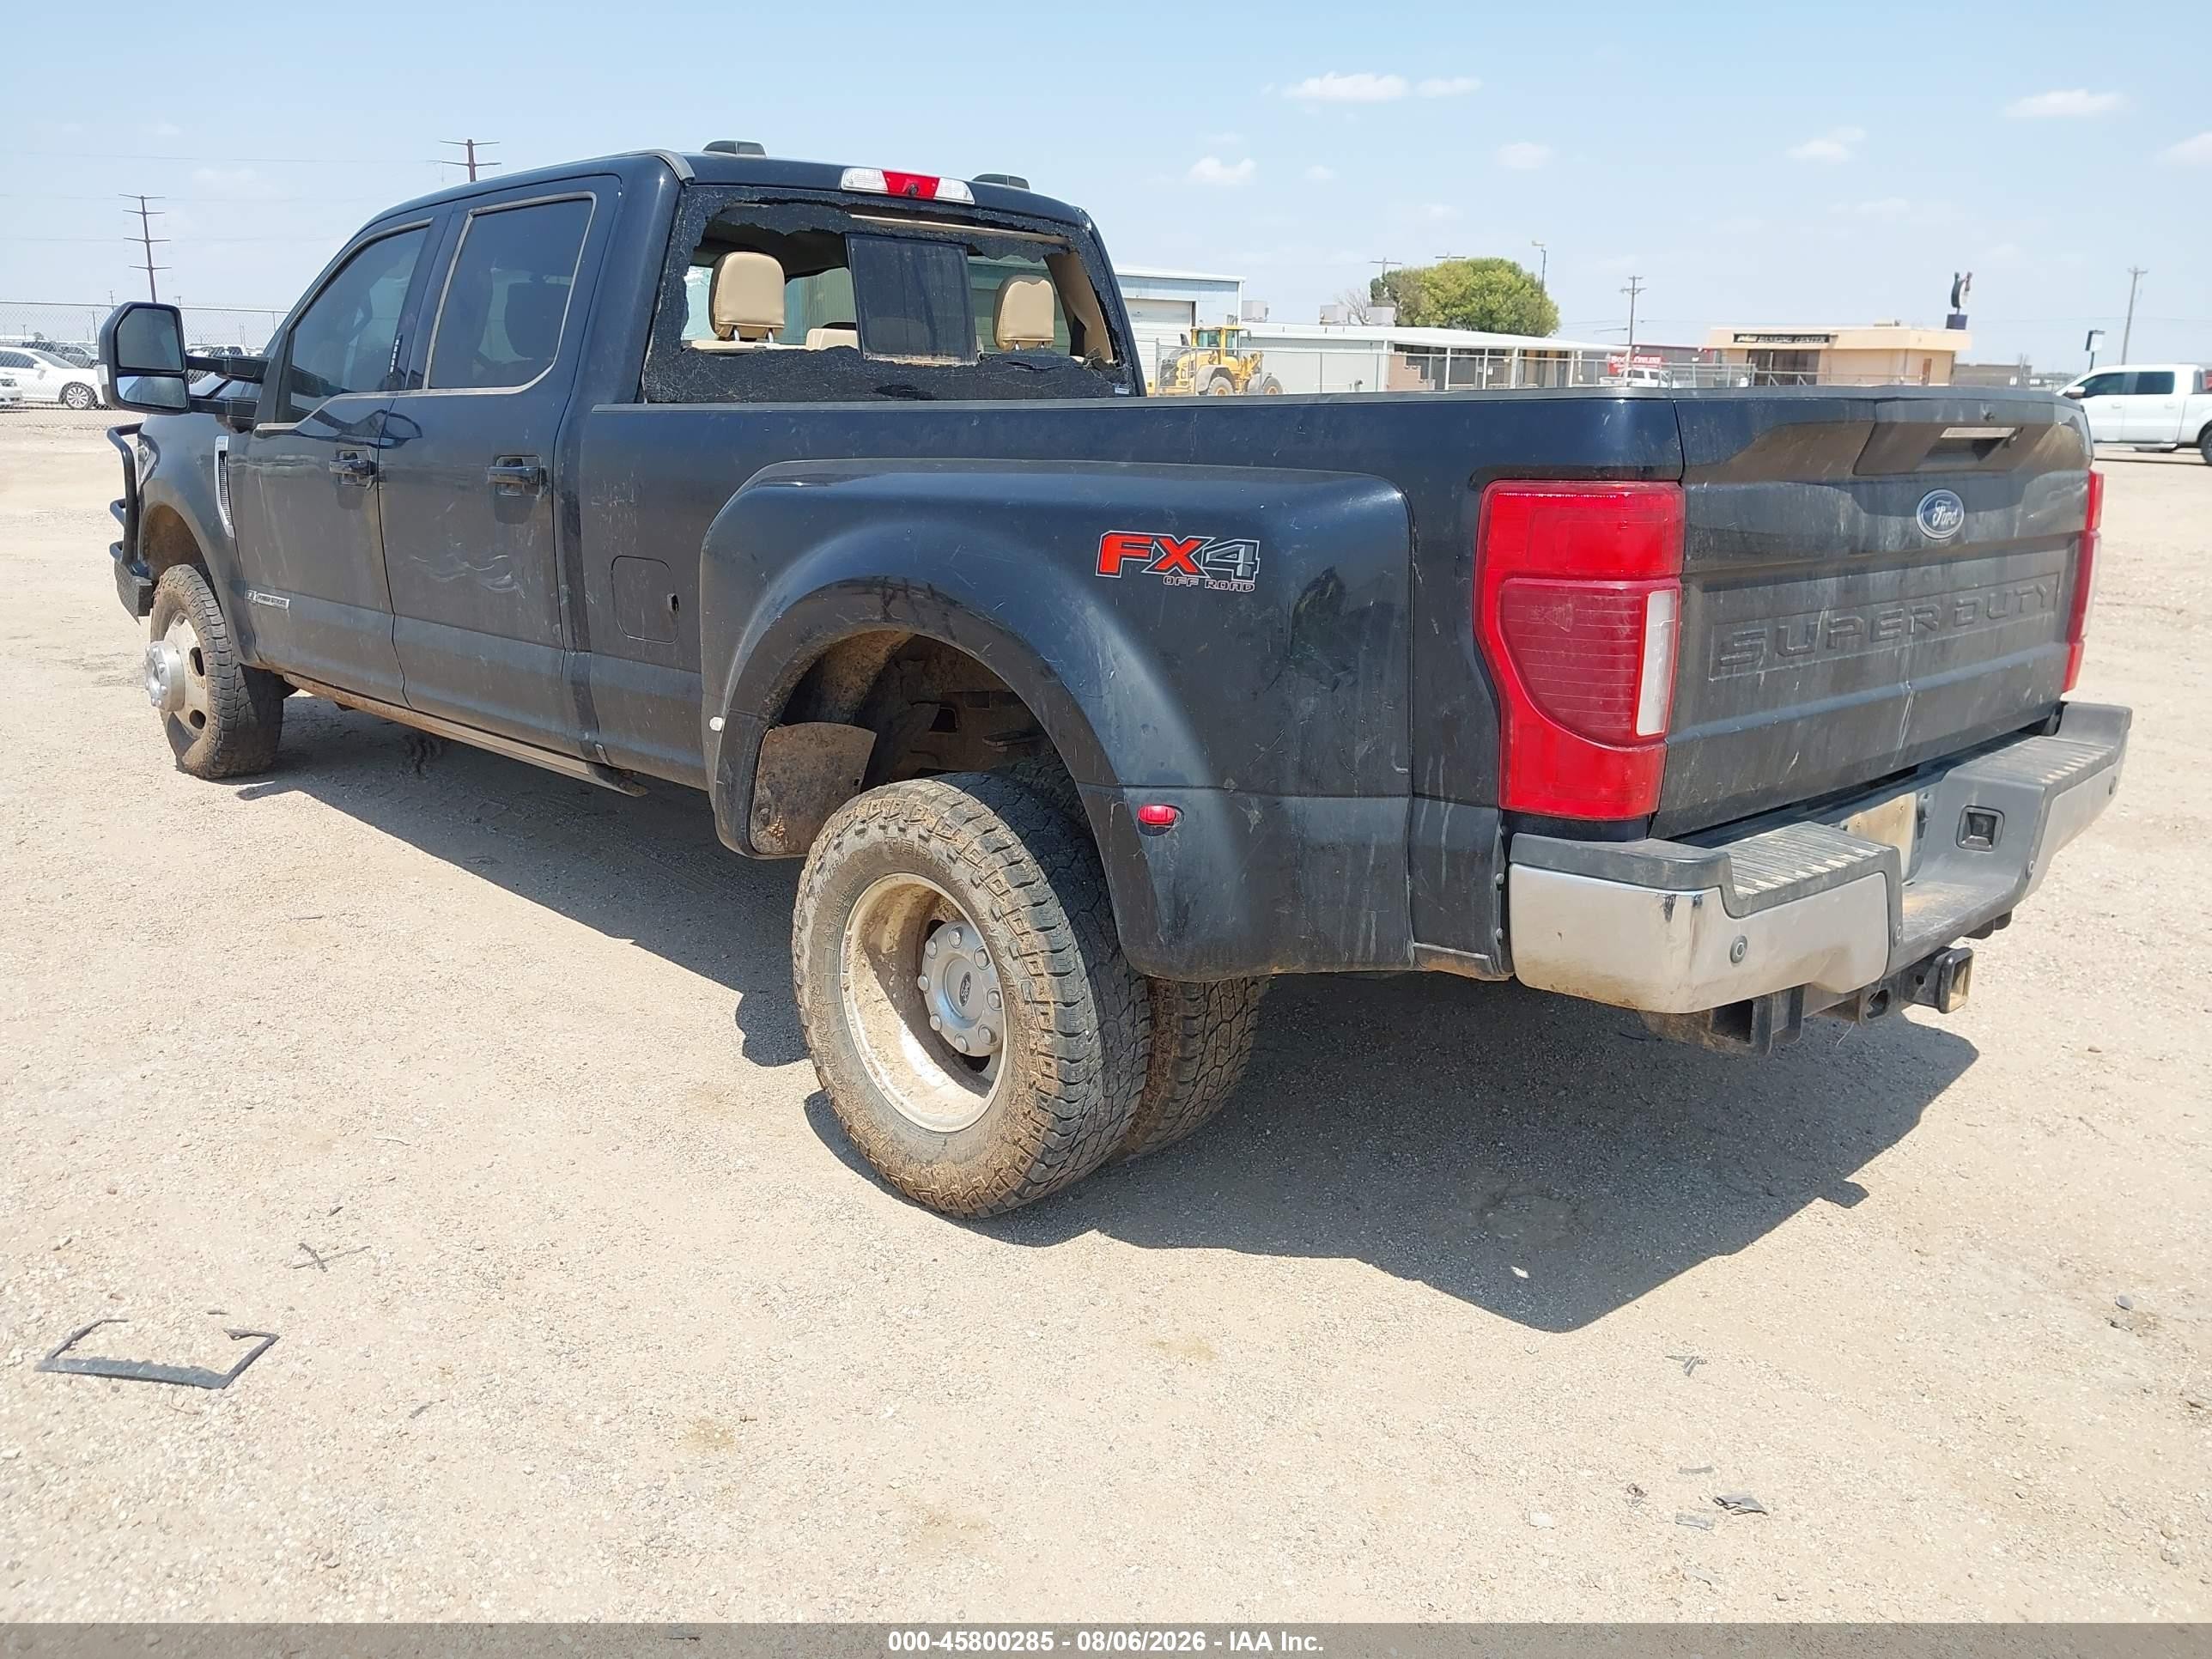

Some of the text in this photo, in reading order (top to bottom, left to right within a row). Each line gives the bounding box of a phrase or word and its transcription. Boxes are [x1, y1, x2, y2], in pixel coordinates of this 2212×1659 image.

[1932, 500, 1958, 526] Ford
[1096, 530, 1260, 582] FX4
[1163, 575, 1255, 592] OFF ROAD
[1718, 582, 2051, 667] SUPER DUTY
